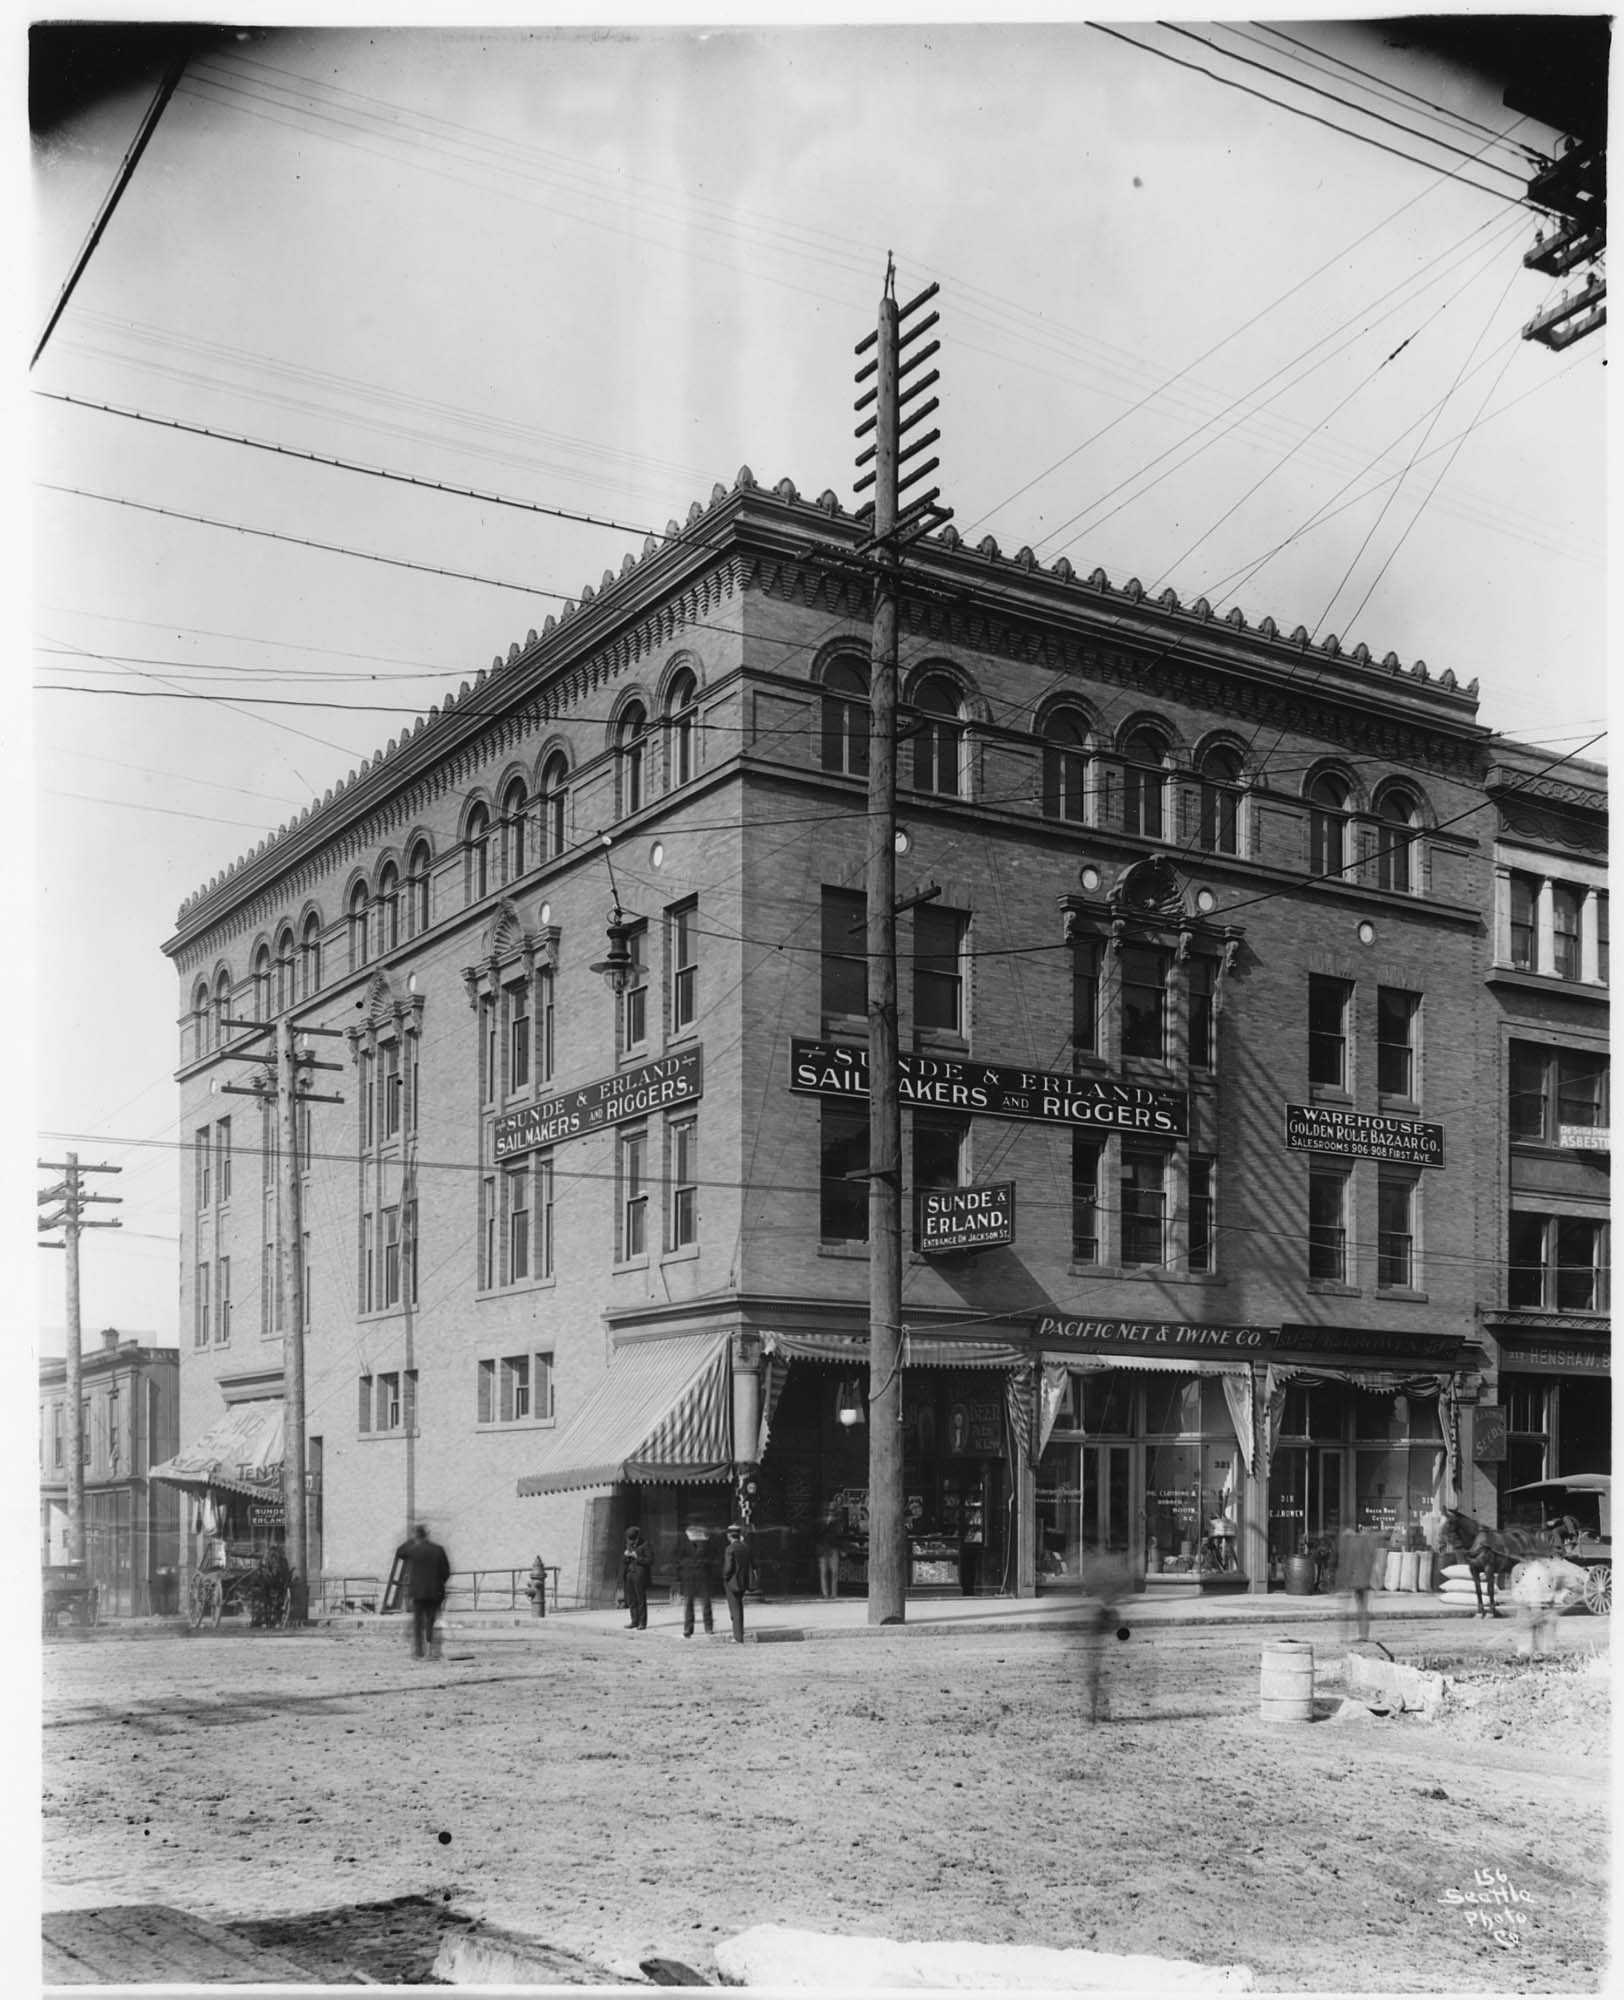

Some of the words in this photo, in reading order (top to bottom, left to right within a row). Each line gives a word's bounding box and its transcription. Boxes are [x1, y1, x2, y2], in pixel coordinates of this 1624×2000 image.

[983, 1068, 999, 1085] &
[505, 1098, 566, 1131] SUNDE
[576, 1092, 588, 1107] &
[600, 1058, 680, 1099] ERLAND
[797, 1064, 988, 1107] SAILAKERS
[1002, 1096, 1030, 1109] AND
[1043, 1096, 1178, 1131] RIGGERS.
[496, 1112, 580, 1155] SAILMAKERS
[588, 1107, 604, 1122] AND
[1289, 1119, 1334, 1139] GOLDEN
[1370, 1129, 1418, 1149] BAZAAR
[1420, 1137, 1441, 1152] CO.
[1303, 1108, 1425, 1136] WAREHOUSE
[1291, 1135, 1349, 1152] SALESROOMS
[1388, 1148, 1411, 1160] FIRST
[927, 1191, 992, 1214] SUNDE
[997, 1191, 1006, 1202] &
[927, 1211, 1008, 1235] ERLAND.
[923, 1236, 957, 1248] ENTRANCE
[968, 1231, 998, 1242] JACKSON
[1039, 1317, 1114, 1339] PACIFIC
[1116, 1323, 1153, 1341] NET
[1155, 1325, 1170, 1342] &
[1175, 1326, 1233, 1345] TWINE
[1235, 1329, 1263, 1347] CO.
